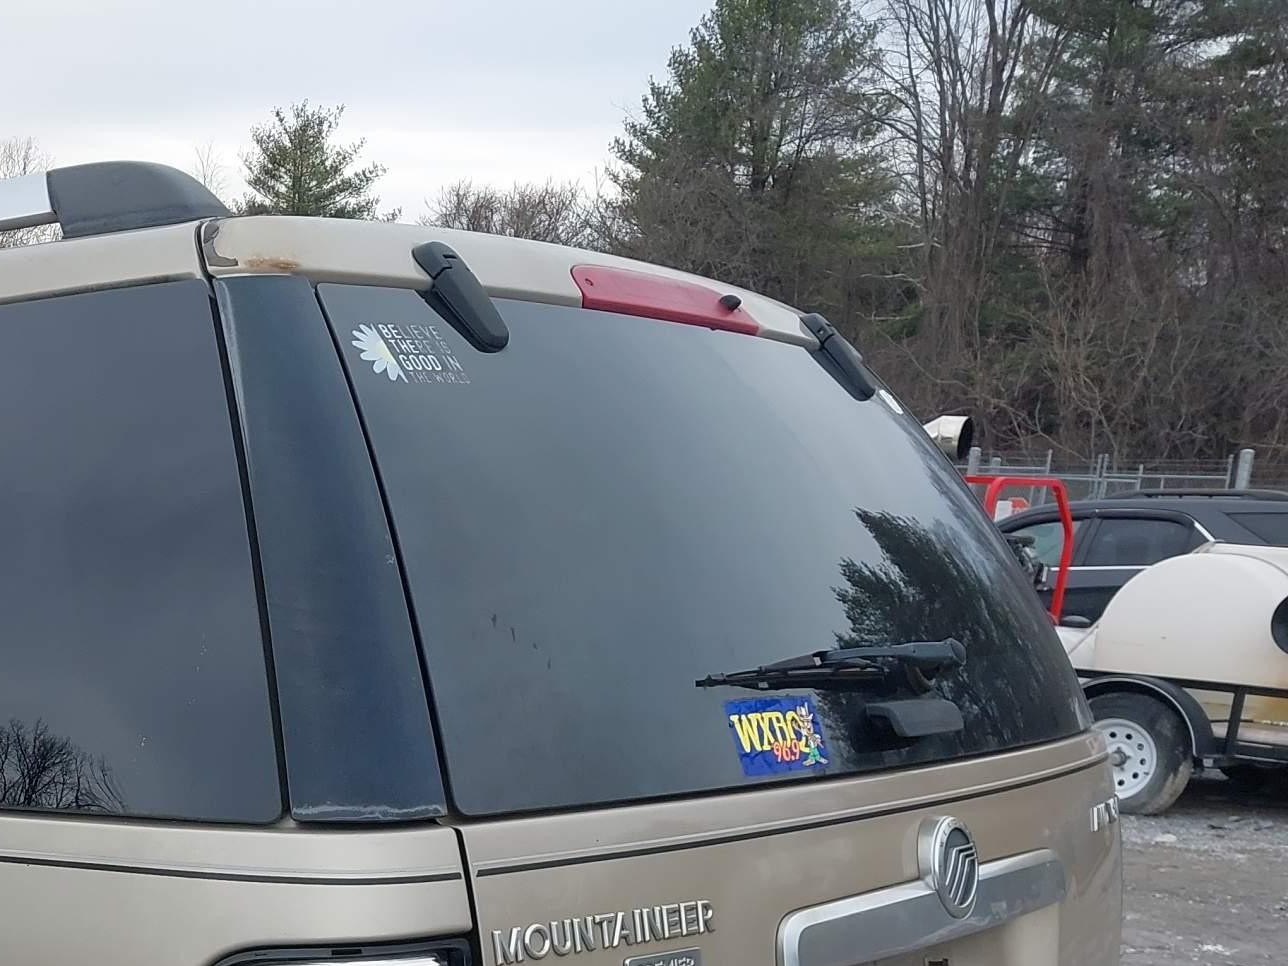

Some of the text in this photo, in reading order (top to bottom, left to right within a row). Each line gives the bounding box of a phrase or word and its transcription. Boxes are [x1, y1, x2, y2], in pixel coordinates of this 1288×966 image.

[378, 323, 444, 340] BELIEVE
[388, 339, 436, 354] THERE
[398, 354, 464, 373] GOOD IN
[408, 371, 472, 385] THE WORLD
[774, 740, 800, 763] 96.9
[492, 899, 716, 966] MOUNTAINEER
